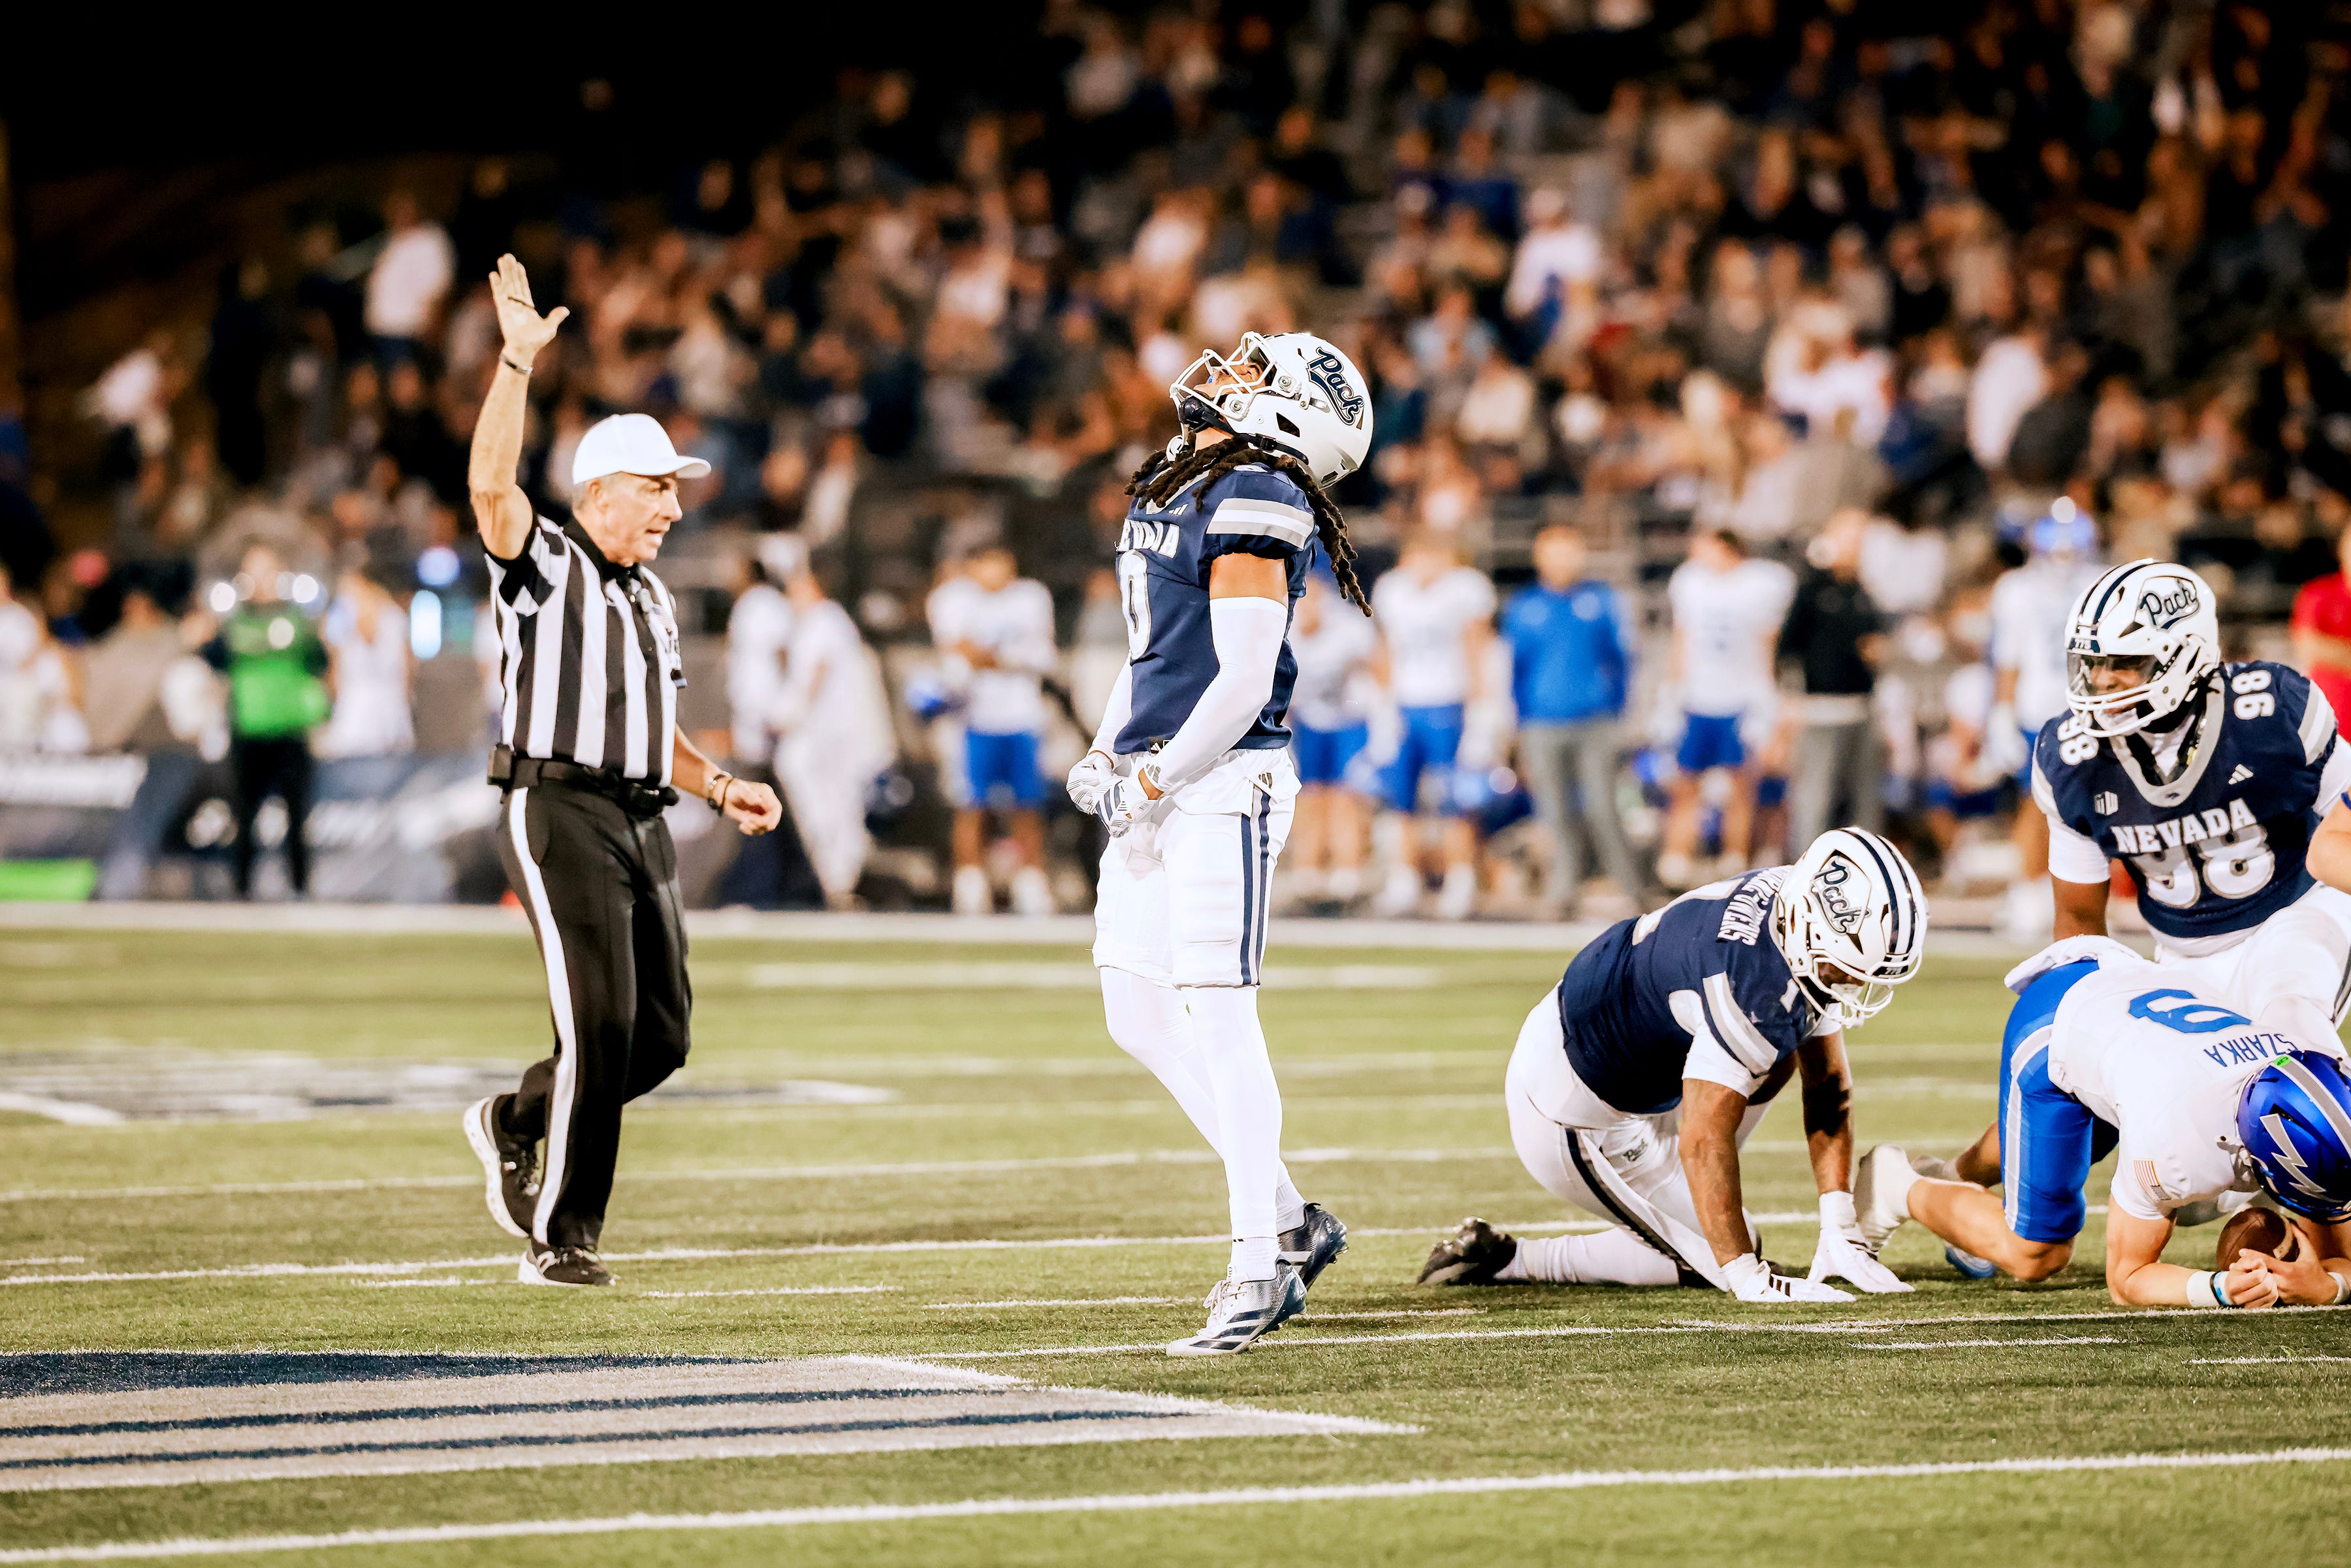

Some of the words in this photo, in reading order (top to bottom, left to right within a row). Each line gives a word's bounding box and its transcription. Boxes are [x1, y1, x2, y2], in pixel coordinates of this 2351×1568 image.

[1306, 347, 1365, 426] Pack
[1119, 549, 1152, 660] 0
[2138, 577, 2200, 631] Pack
[2231, 670, 2275, 720] 98
[2111, 798, 2257, 854] NEVADA
[1809, 856, 1872, 935] Pack
[2203, 1033, 2298, 1067] SZARKA
